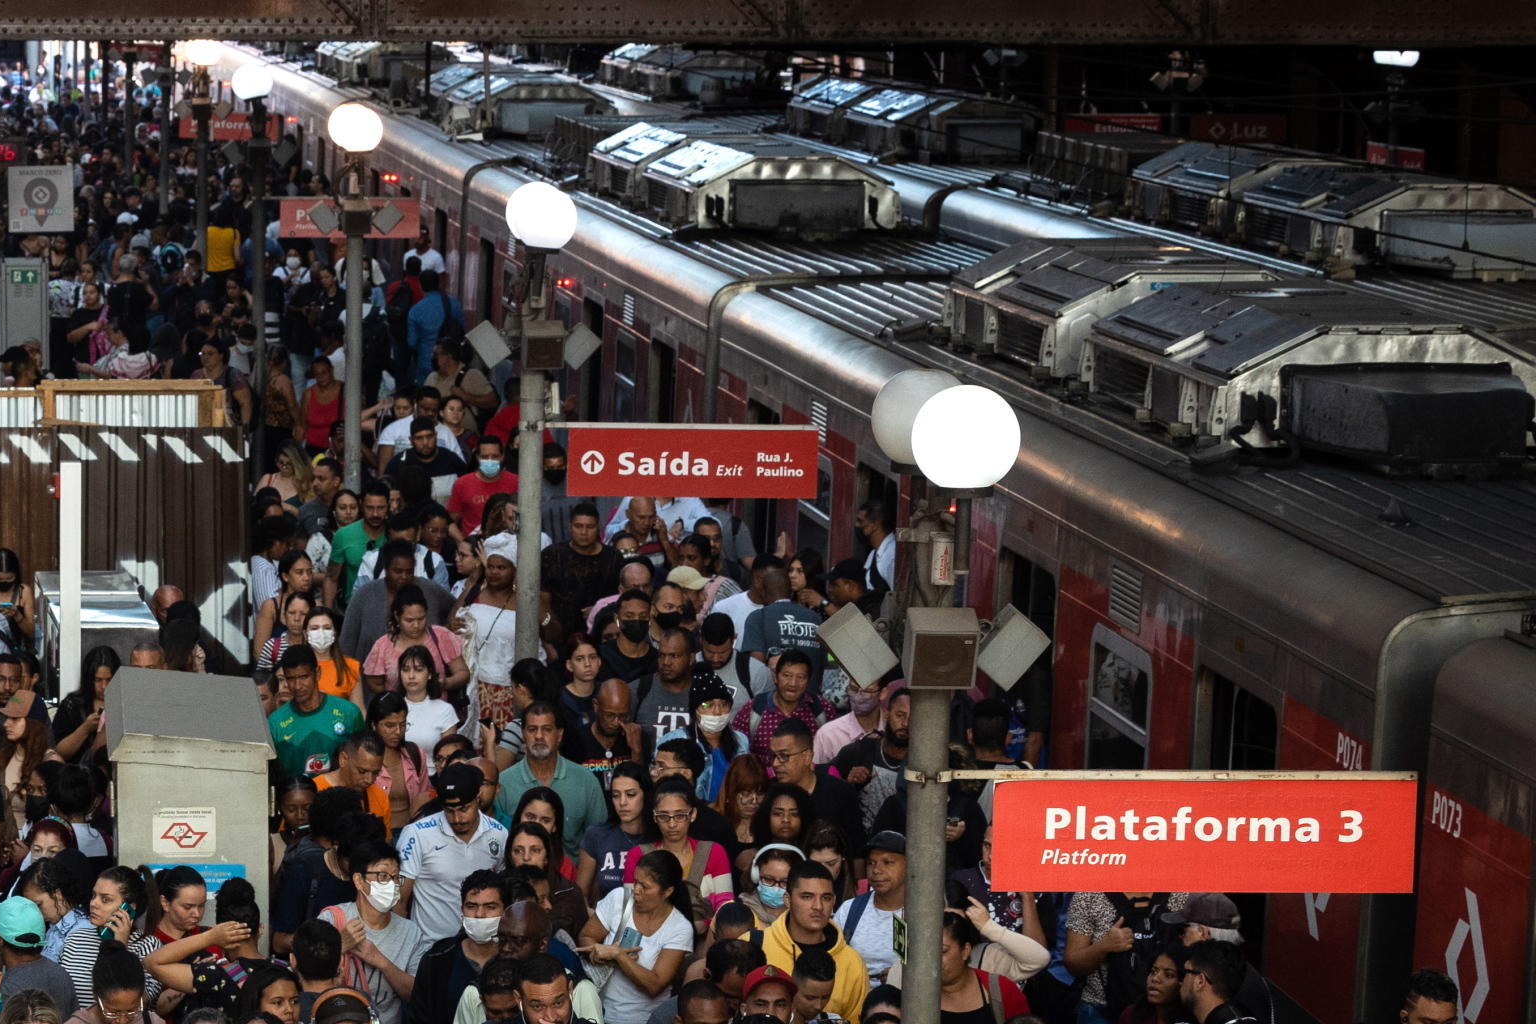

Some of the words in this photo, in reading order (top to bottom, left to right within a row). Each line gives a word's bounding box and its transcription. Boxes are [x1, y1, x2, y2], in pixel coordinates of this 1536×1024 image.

[617, 451, 709, 476] Saída
[715, 465, 744, 477] Exit
[757, 452, 781, 463] Rua
[784, 453, 793, 463] J.
[756, 466, 804, 478] Paulino
[1336, 731, 1363, 771] P074
[415, 818, 439, 830] Itaú
[1044, 806, 1321, 843] Plataforma
[1337, 809, 1364, 843] 3
[1431, 790, 1463, 838] P073
[402, 836, 416, 862] vivo
[1040, 848, 1127, 866] Platform
